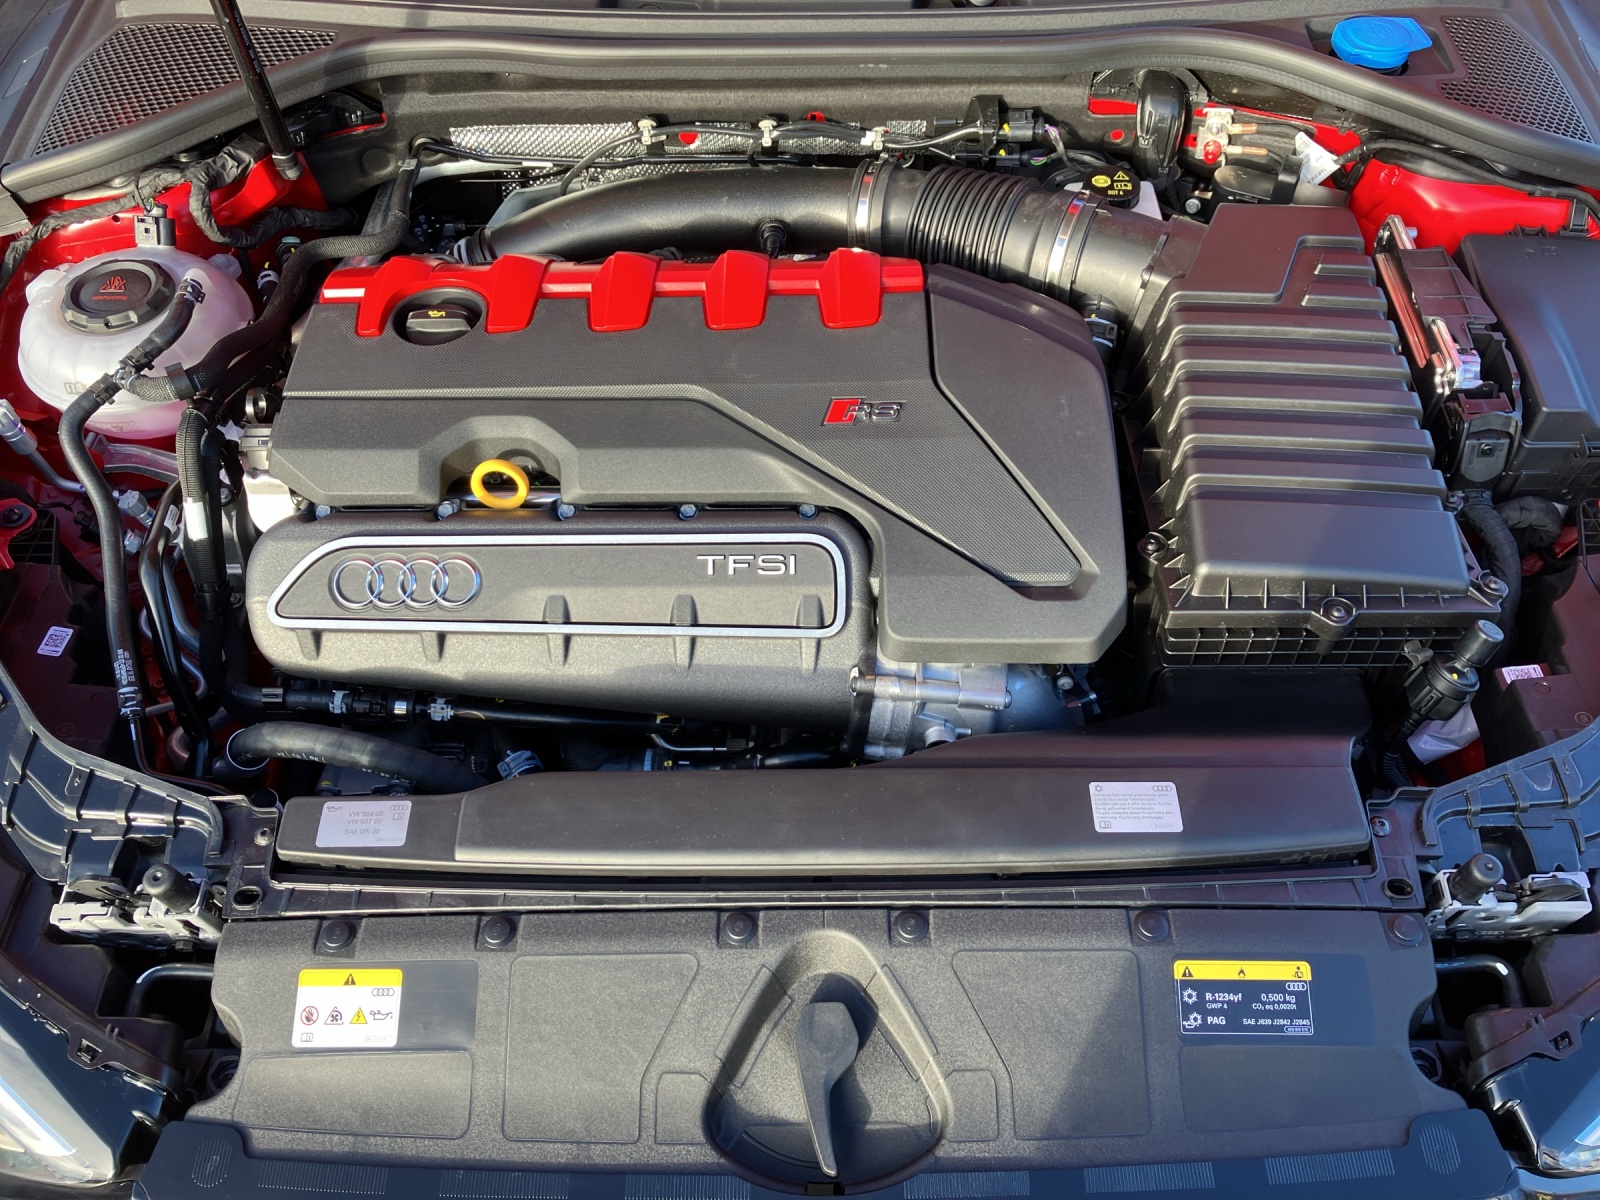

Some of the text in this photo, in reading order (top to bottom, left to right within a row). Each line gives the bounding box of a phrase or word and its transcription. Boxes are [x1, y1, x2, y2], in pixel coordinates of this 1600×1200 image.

[696, 554, 797, 575] TFSI
[1205, 993, 1242, 1002] R-1234yf
[1261, 993, 1296, 1003] 0,500 kg
[1207, 1016, 1226, 1025] PAG
